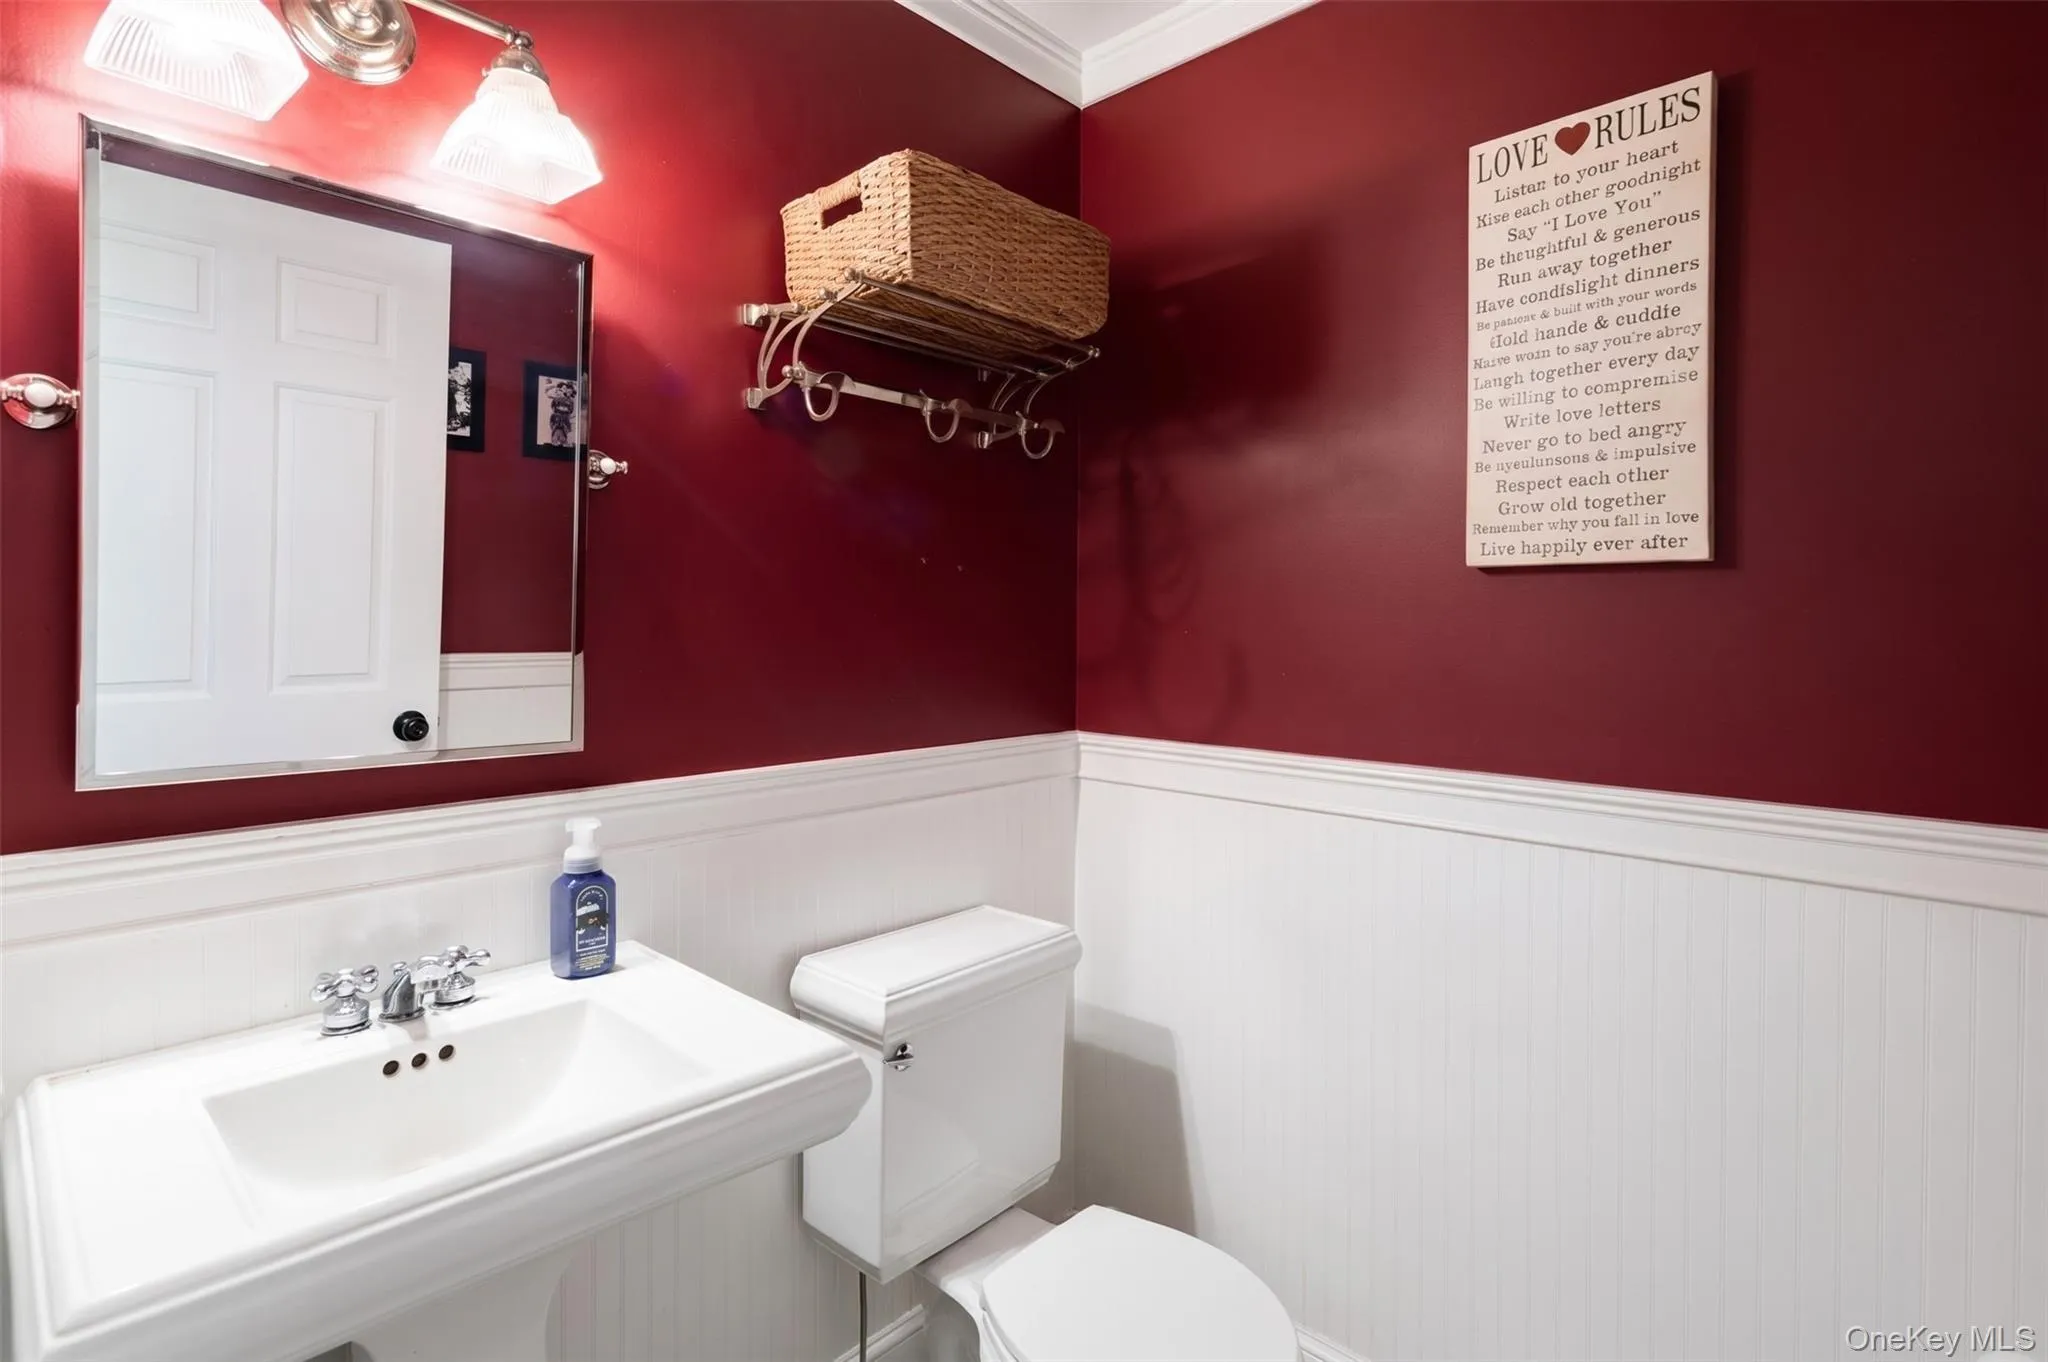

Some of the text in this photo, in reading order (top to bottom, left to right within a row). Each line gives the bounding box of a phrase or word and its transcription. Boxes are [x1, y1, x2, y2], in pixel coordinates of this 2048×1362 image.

[1477, 86, 1701, 184] LOVE RULES
[1554, 172, 1570, 186] to
[1576, 159, 1620, 184] your
[1626, 140, 1679, 166] heart
[1514, 199, 1550, 218] each
[1555, 187, 1600, 207] other
[1605, 158, 1701, 198] goodnight
[1475, 257, 1495, 272] Be
[1593, 229, 1608, 243] &
[1613, 209, 1701, 242] generous
[1507, 226, 1538, 242] Say
[1565, 208, 1607, 228] Love
[1497, 240, 1672, 288] Run away together
[1476, 297, 1515, 314] Have
[1625, 258, 1700, 283] dinners
[1540, 309, 1550, 320] &
[1585, 297, 1614, 310] with
[1617, 290, 1650, 307] your
[1655, 281, 1697, 297] words
[1594, 315, 1609, 330] &
[1530, 361, 1602, 382] together
[1608, 352, 1658, 369] every
[1665, 345, 1700, 361] day
[1556, 344, 1570, 356] to
[1574, 340, 1599, 353] say
[1474, 398, 1493, 412] Be
[1499, 390, 1556, 408] willing
[1562, 386, 1578, 399] to
[1504, 399, 1661, 428] Write love letters
[1482, 420, 1687, 454] Never go to bed angry
[1474, 462, 1491, 473] Be
[1595, 449, 1608, 461] &
[1614, 441, 1696, 461] impulsive
[1495, 466, 1669, 494] Respect each other
[1498, 491, 1666, 515] Grow old together
[1473, 511, 1700, 535] Remember why you fall in love
[1480, 534, 1688, 558] Live happily ever after
